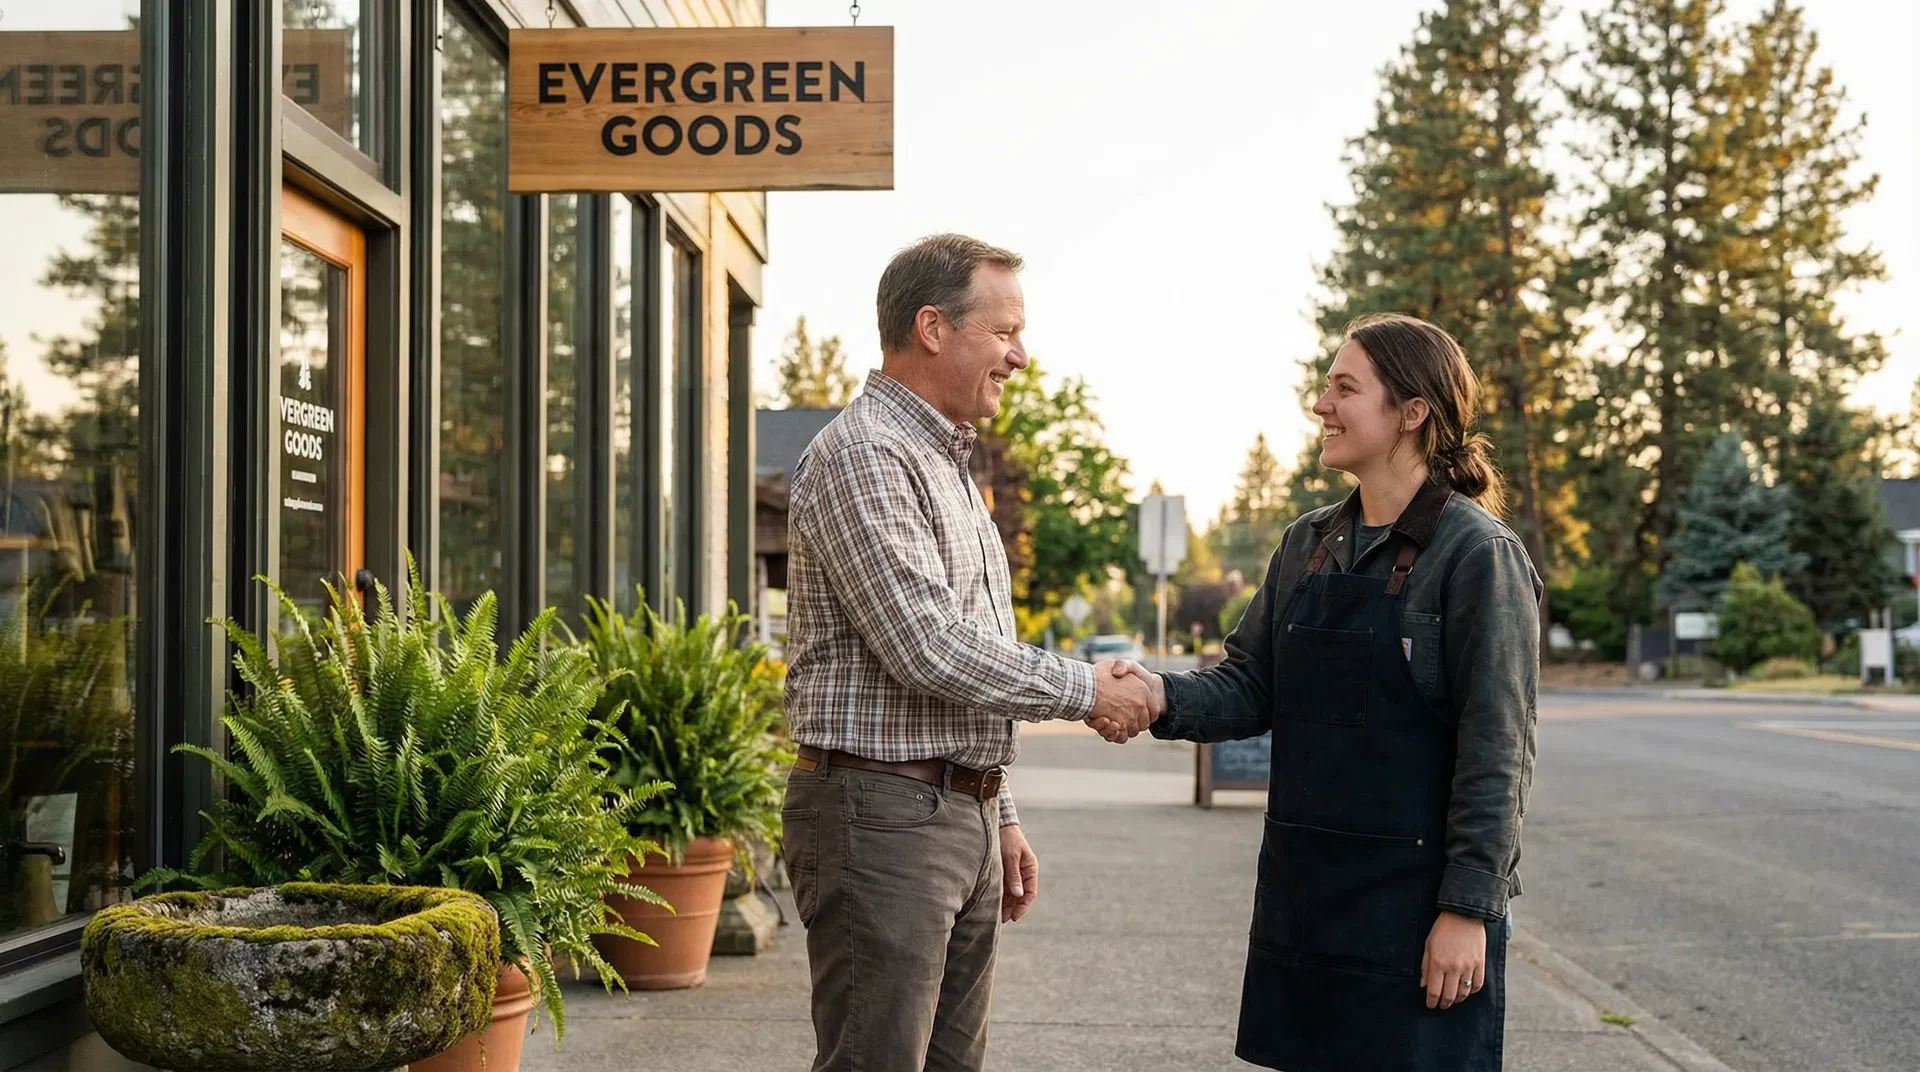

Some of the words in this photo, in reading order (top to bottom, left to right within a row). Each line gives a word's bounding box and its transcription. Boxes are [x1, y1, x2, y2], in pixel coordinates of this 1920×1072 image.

[538, 61, 866, 104] EVERGREEN
[601, 114, 803, 156] GOODS
[280, 395, 335, 433] VERGREEN
[284, 429, 323, 461] GOODS
